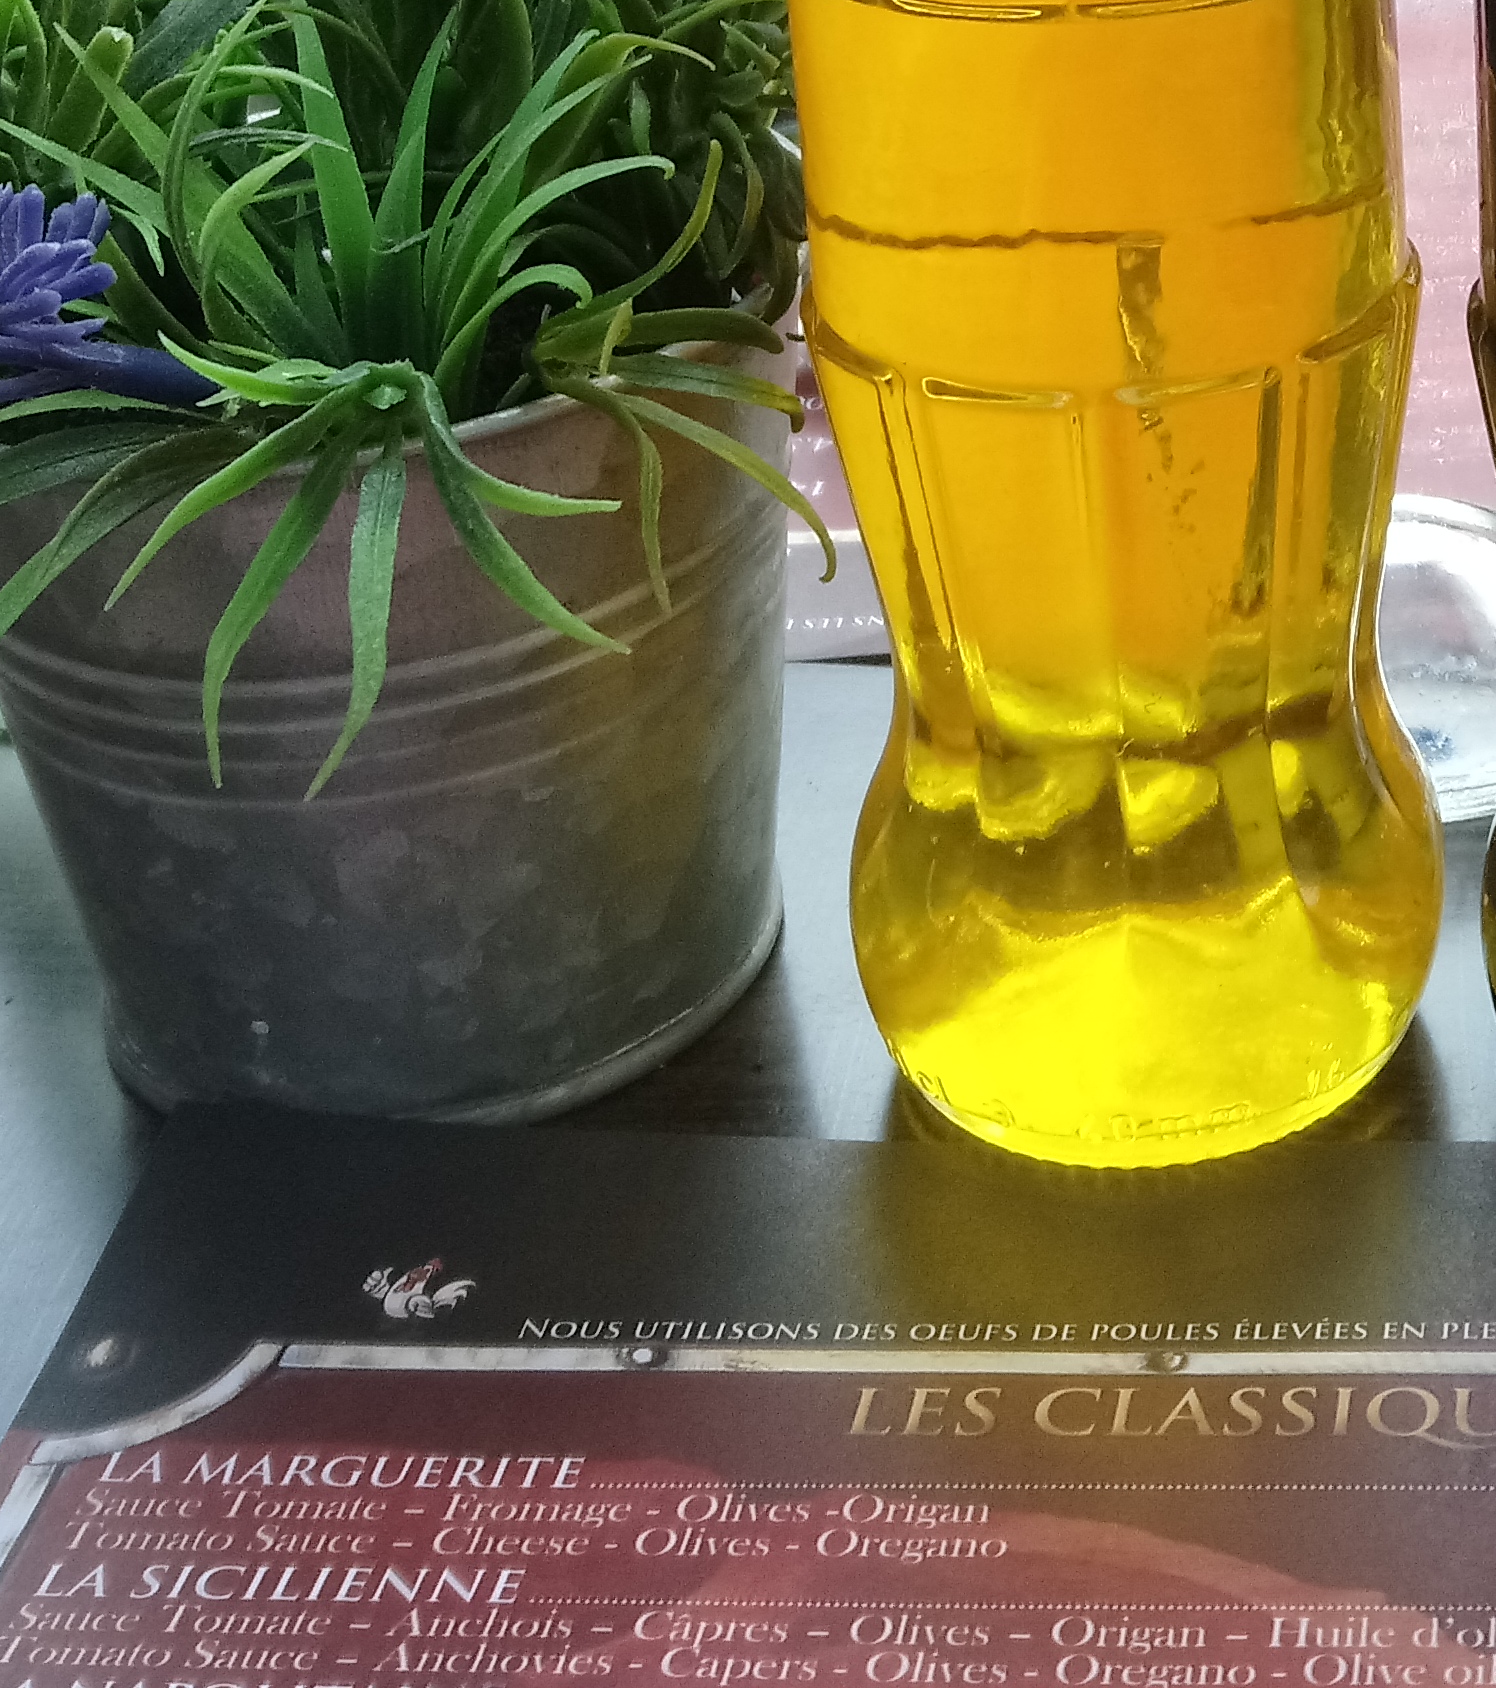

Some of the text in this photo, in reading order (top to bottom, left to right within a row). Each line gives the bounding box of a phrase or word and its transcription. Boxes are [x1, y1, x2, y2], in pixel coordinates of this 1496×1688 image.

[517, 1315, 623, 1341] NOUS
[633, 1318, 822, 1343] UTILISONS
[832, 1320, 899, 1343] DES
[907, 1320, 1021, 1343] OEUFS
[1030, 1321, 1078, 1343] DE
[1089, 1320, 1222, 1343] POULES
[1232, 1315, 1370, 1343] ÉLEVÉES
[1382, 1320, 1430, 1342] EN
[848, 1386, 1003, 1438] LES
[98, 1451, 587, 1490] LA MARGUERITE
[74, 1486, 204, 1520] Sauce
[222, 1488, 388, 1523] Tomate
[441, 1493, 634, 1525] Fromage
[675, 1493, 811, 1525] Olives
[64, 1520, 1009, 1565] Tomato Sauce Cheese Olives Oregano
[33, 1563, 528, 1605] LA SICILIENNE
[8, 1602, 141, 1634] Sauce
[161, 1603, 333, 1637] Tomate
[385, 1607, 573, 1641] Anchois
[632, 1607, 790, 1653] Câpres
[850, 1613, 991, 1648] Olives
[1050, 1614, 1207, 1655] Origan
[1268, 1615, 1397, 1650] Huile
[184, 1637, 320, 1672] Sauce
[373, 1642, 614, 1677] Anchovies
[659, 1646, 819, 1687] Capers
[865, 1650, 1009, 1685] Olives
[1055, 1652, 1258, 1688] Oregano
[1303, 1652, 1428, 1686] Olive
